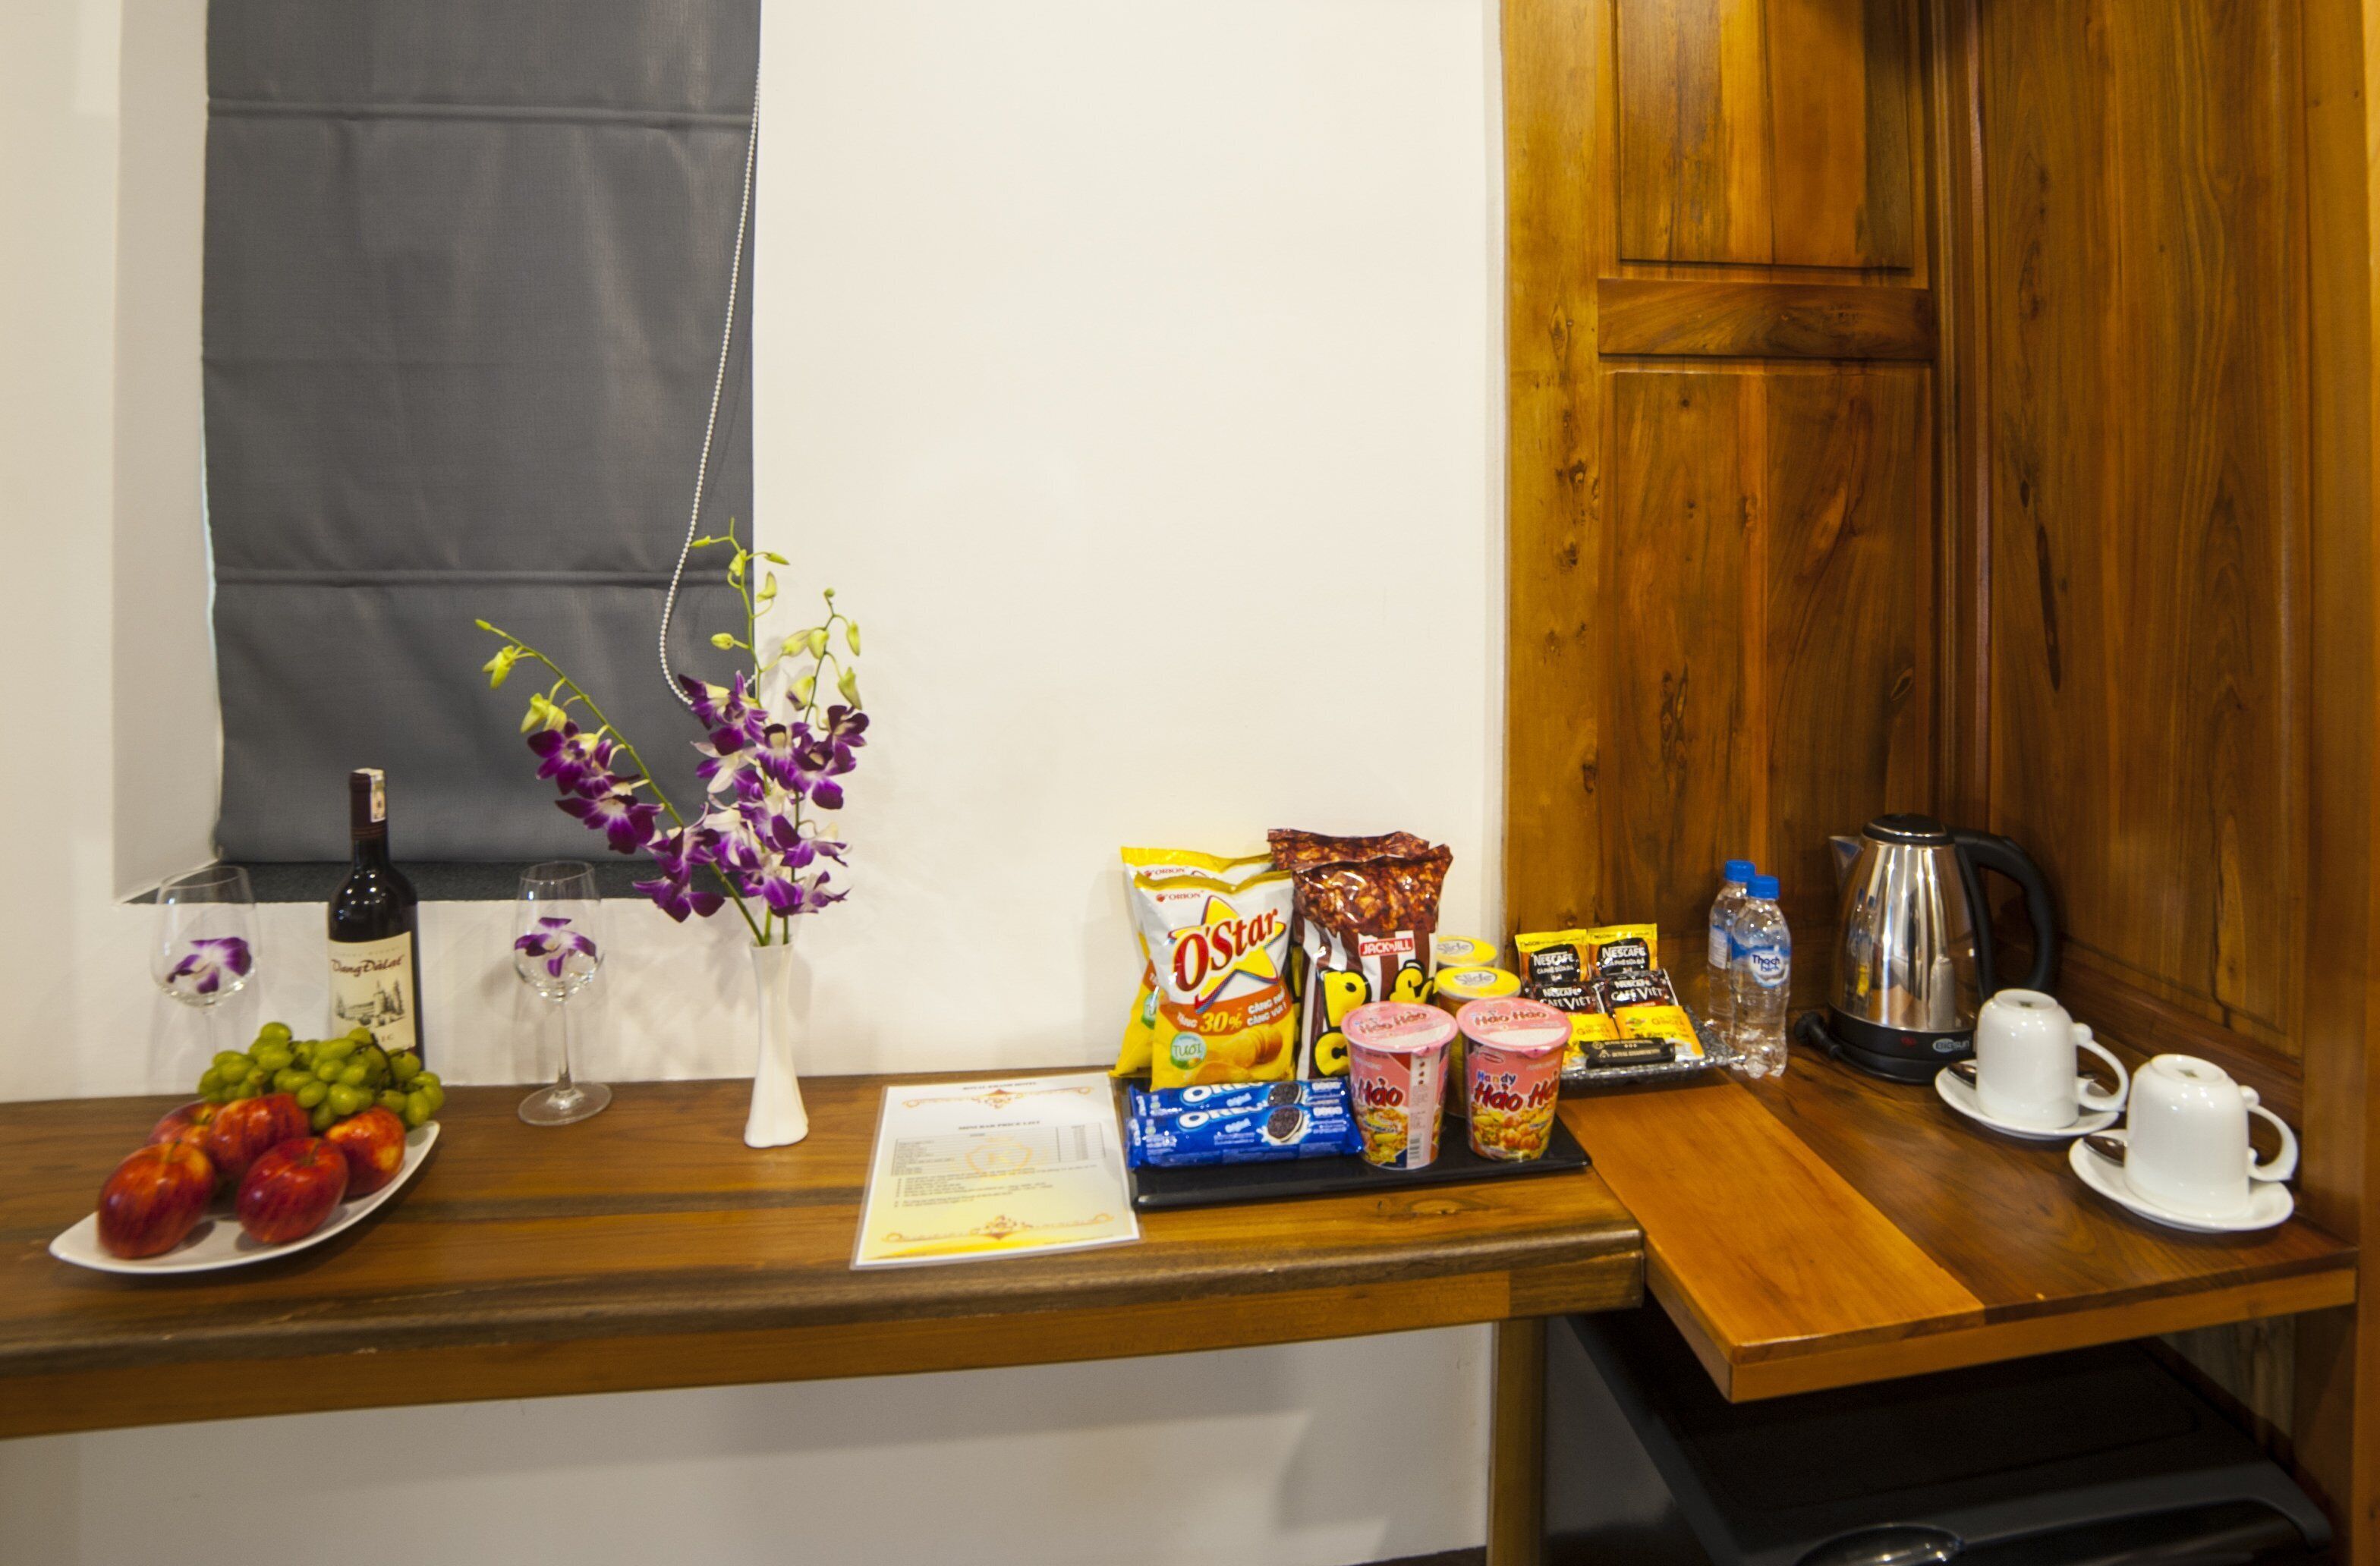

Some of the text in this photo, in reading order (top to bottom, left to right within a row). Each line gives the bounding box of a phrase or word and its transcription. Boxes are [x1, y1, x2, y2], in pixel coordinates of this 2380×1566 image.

[1168, 892, 1201, 901] ORION
[1173, 908, 1278, 992] O'Star
[1200, 1011, 1242, 1033] 30%
[1474, 1070, 1558, 1112] Hảo Hả
[1476, 1070, 1517, 1086] Handy
[1358, 1077, 1404, 1107] Hảo
